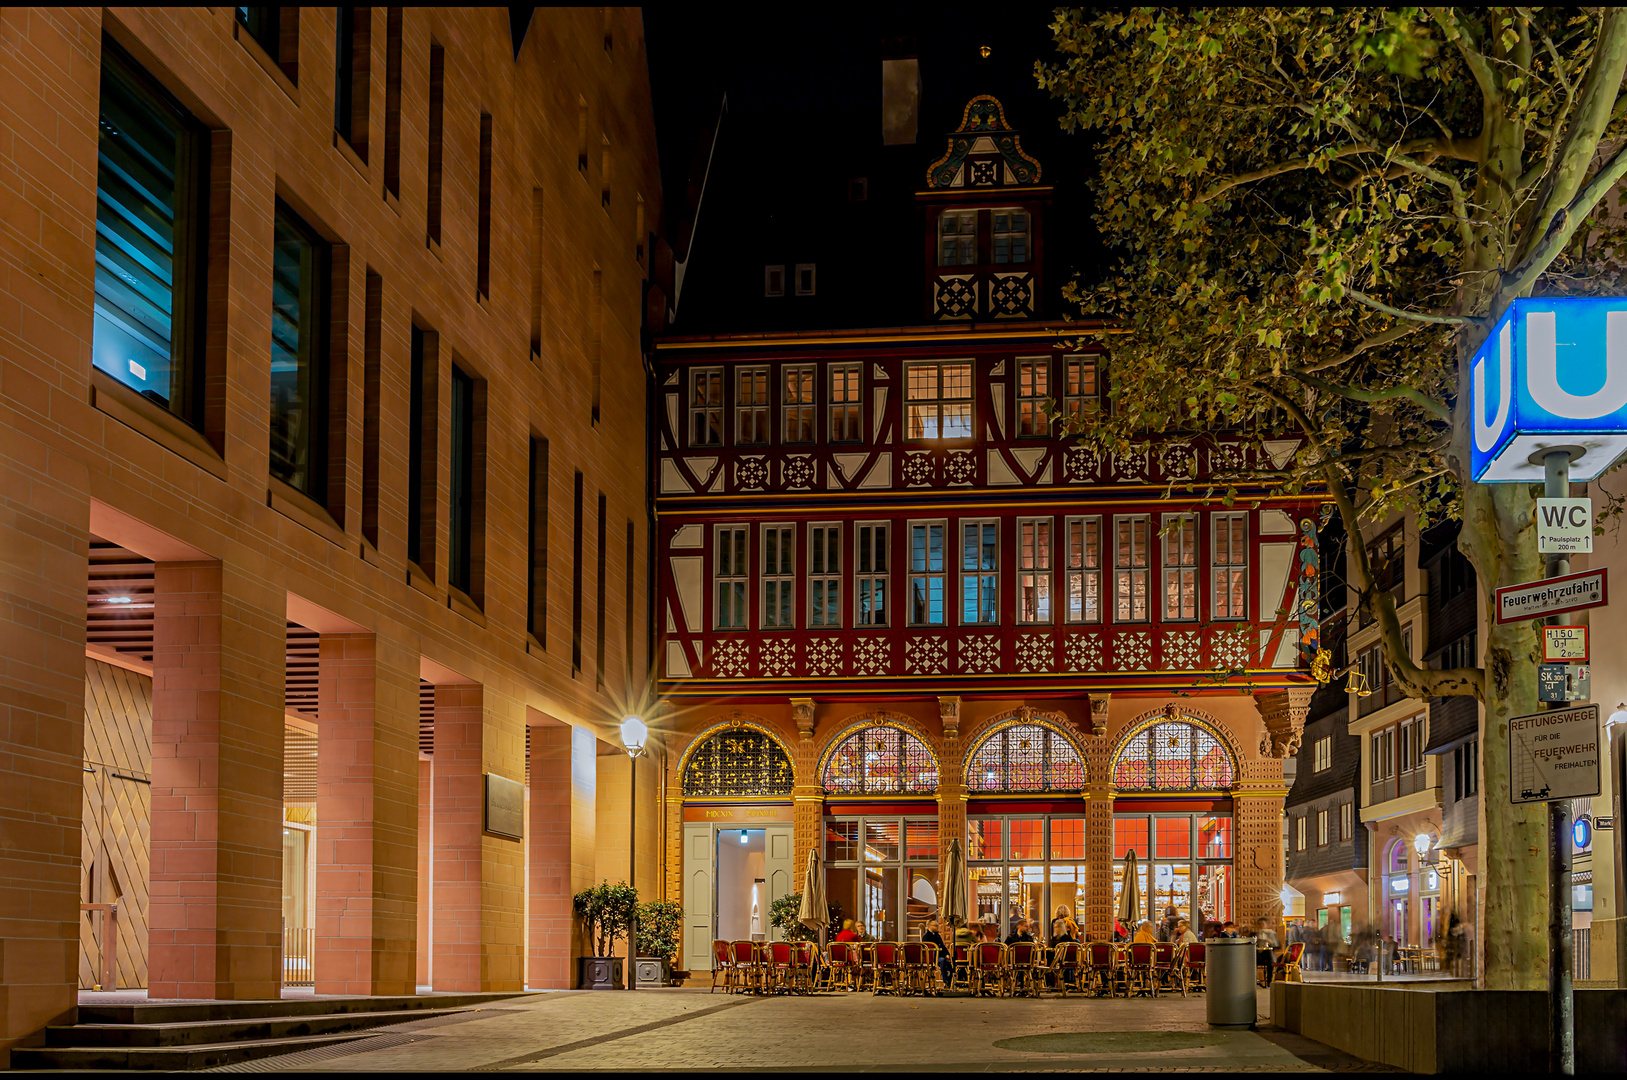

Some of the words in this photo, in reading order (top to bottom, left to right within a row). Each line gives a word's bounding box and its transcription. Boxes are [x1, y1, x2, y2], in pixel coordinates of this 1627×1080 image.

[1527, 311, 1627, 420] U
[1474, 319, 1511, 453] U
[1541, 506, 1587, 528] WC
[1503, 579, 1600, 608] Feuerwehrzufahrt
[1541, 672, 1552, 681] SK
[1512, 710, 1595, 732] RETTUNGSWEGE
[1534, 734, 1548, 742] FÜR
[1534, 742, 1596, 759] FEUERWEHR
[1554, 760, 1597, 770] FREIHALTEN
[1575, 824, 1584, 843] U
